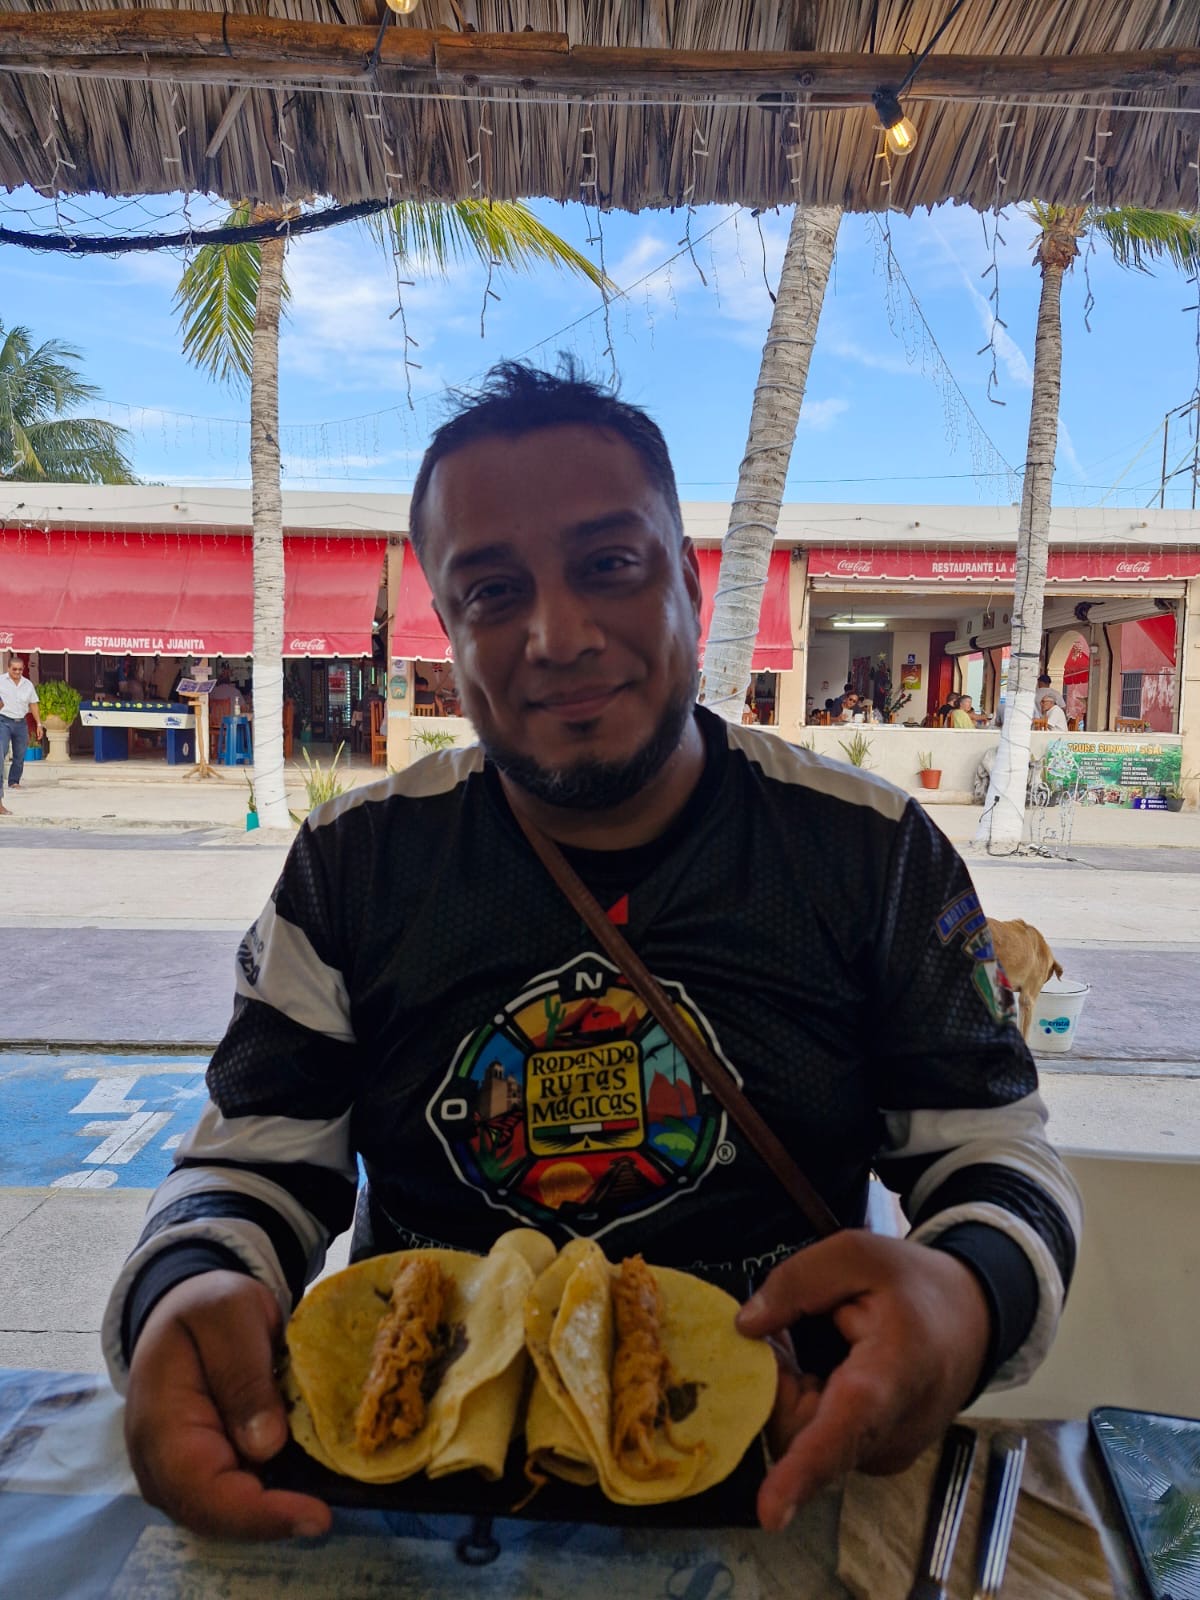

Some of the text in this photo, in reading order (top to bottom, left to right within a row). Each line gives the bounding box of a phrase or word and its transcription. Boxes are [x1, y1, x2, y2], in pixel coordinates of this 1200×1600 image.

[932, 562, 993, 573] RESTAURANTE
[995, 562, 1006, 573] LA
[84, 635, 205, 650] RESTAURANTE LA JUANITA
[1067, 743, 1096, 753] TOURS
[575, 972, 603, 991] N
